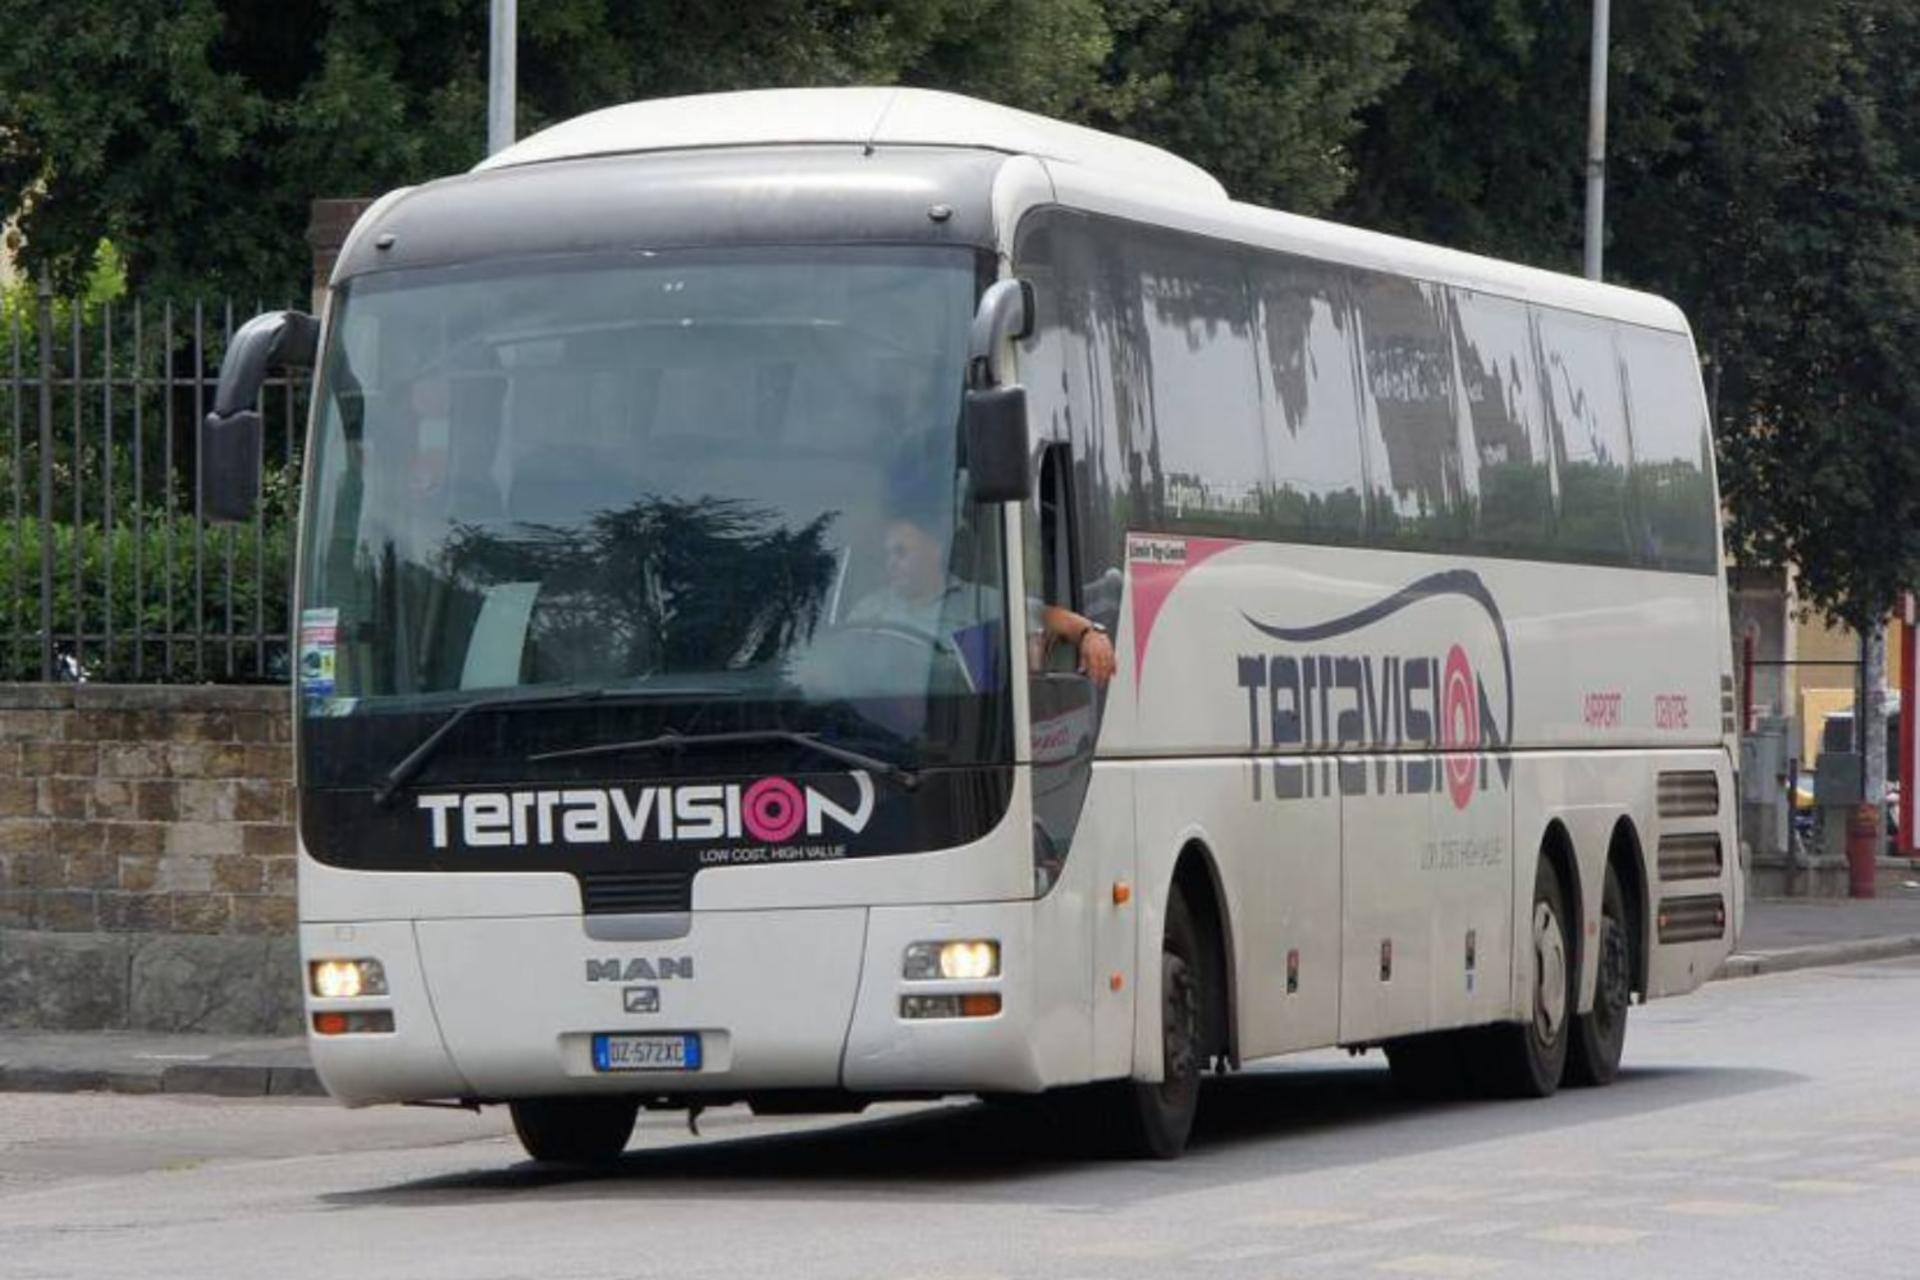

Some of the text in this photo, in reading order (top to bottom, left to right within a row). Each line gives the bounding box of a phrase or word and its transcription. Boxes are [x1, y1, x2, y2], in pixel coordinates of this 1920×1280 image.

[417, 769, 875, 848] TerraVISION
[700, 849, 729, 863] LOW
[771, 845, 803, 859] HIGH
[807, 843, 847, 857] VALUE
[586, 956, 693, 982] MAN
